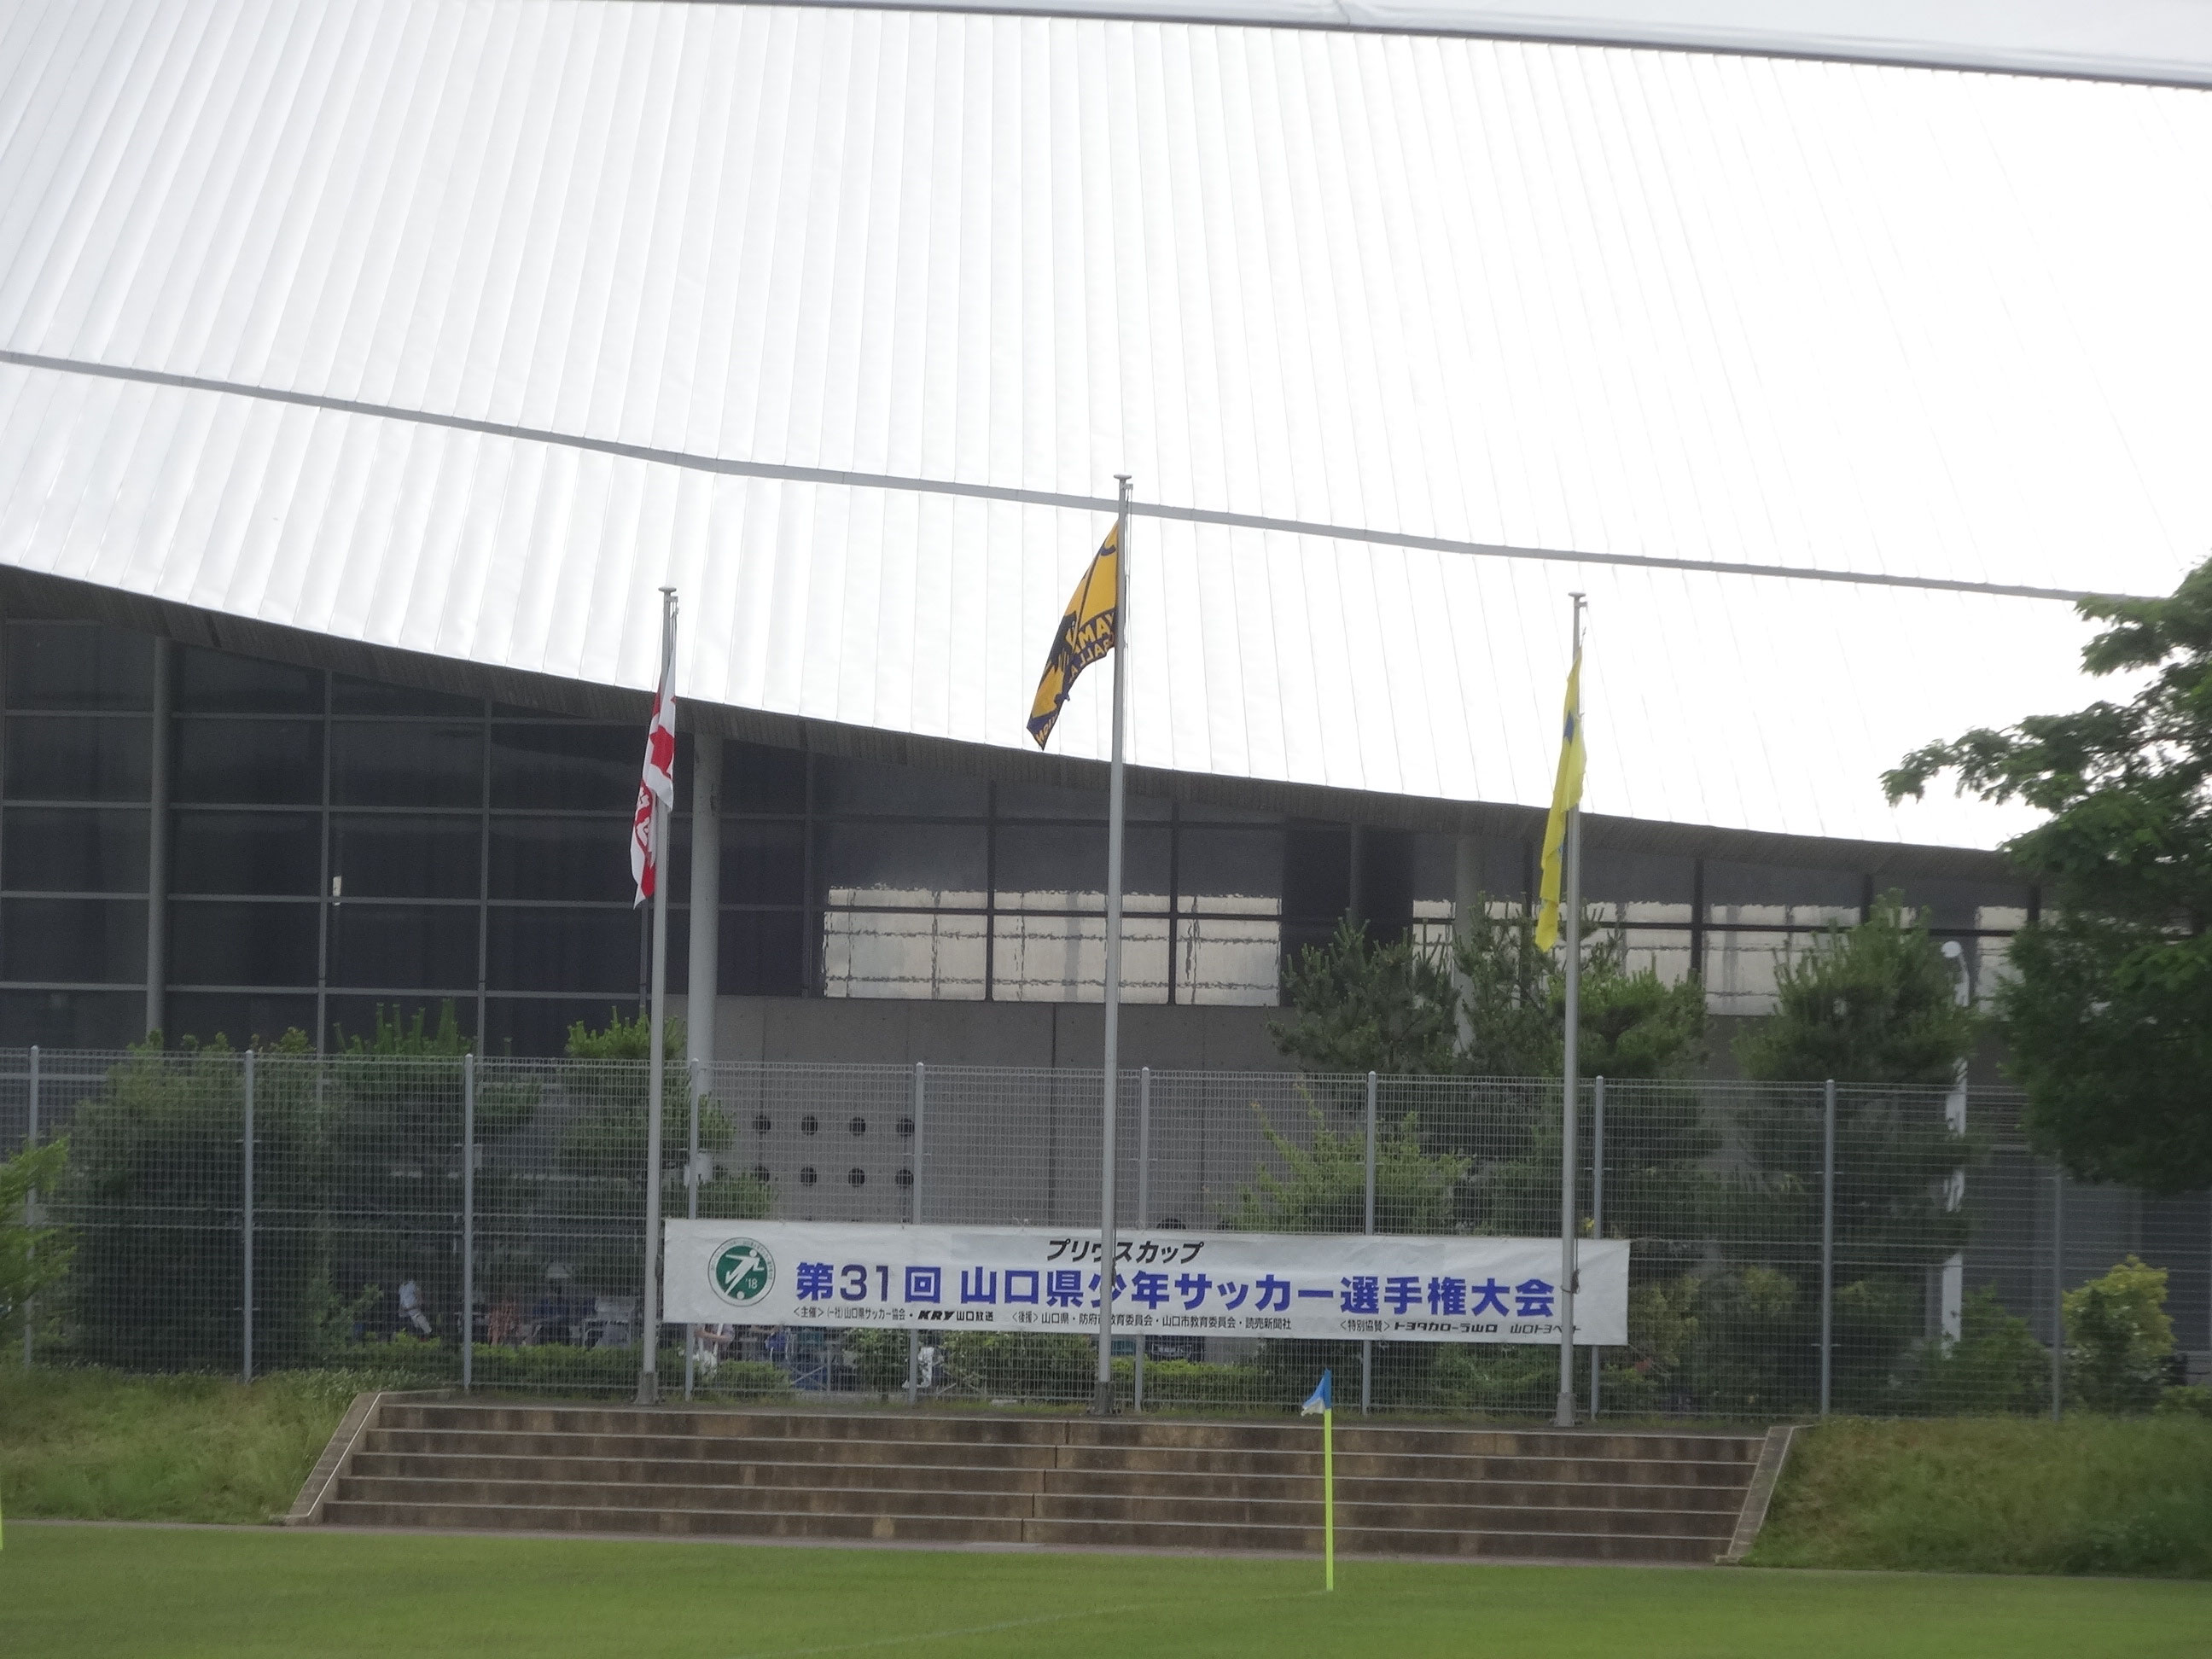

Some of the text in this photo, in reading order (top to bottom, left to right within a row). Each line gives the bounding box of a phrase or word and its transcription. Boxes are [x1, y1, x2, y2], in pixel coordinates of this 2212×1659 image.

[796, 1261, 1555, 1318] 第31回 山口県少年サッカー選手権大会
